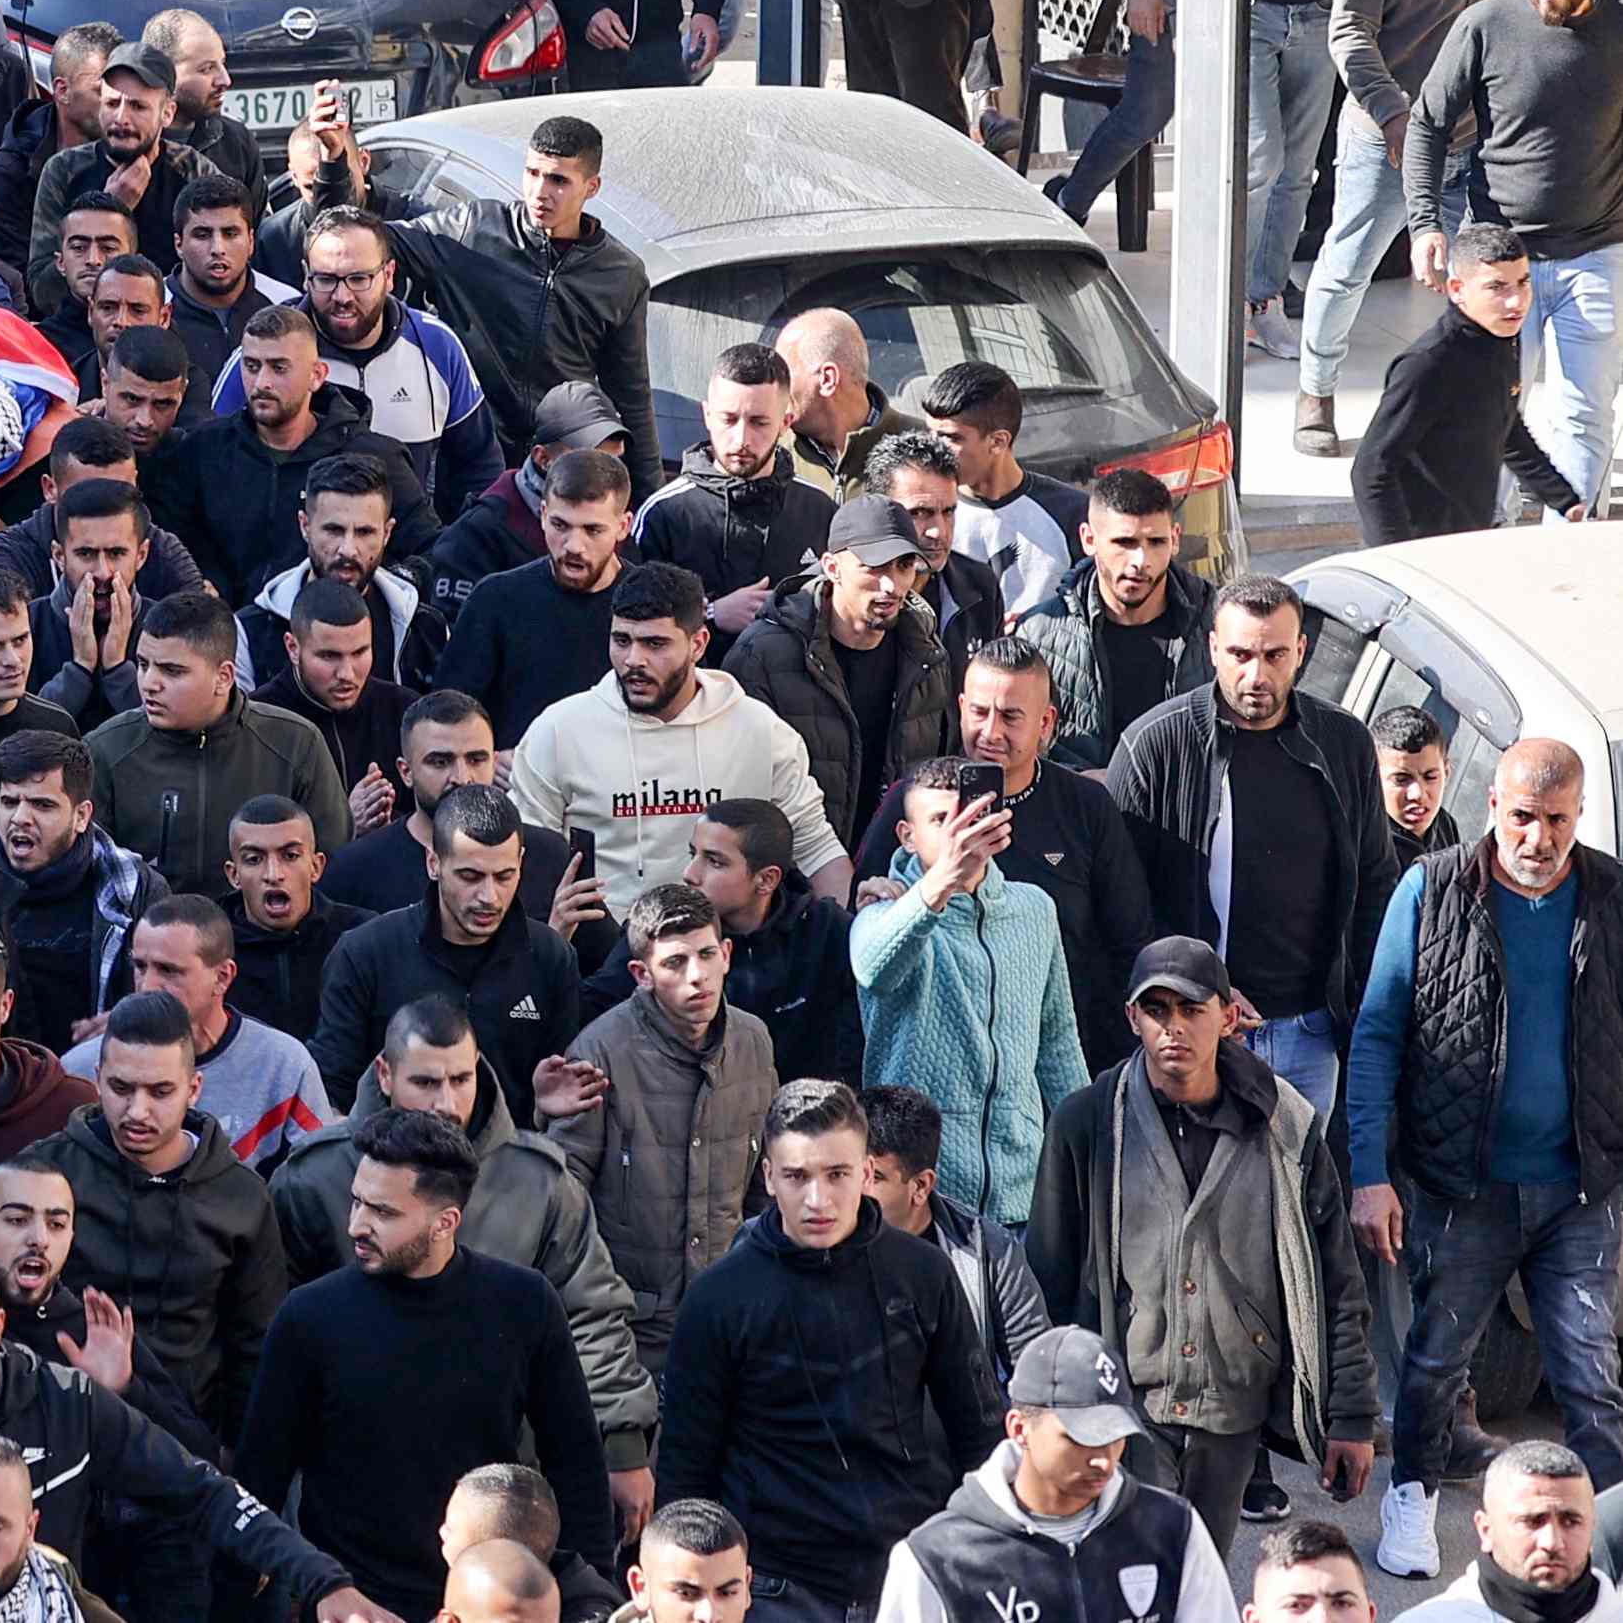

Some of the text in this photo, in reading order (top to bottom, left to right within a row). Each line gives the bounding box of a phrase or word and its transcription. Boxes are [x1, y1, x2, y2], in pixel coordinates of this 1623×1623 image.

[236, 91, 305, 124] 3670
[613, 779, 722, 809] milano
[616, 806, 682, 816] ROERTO
